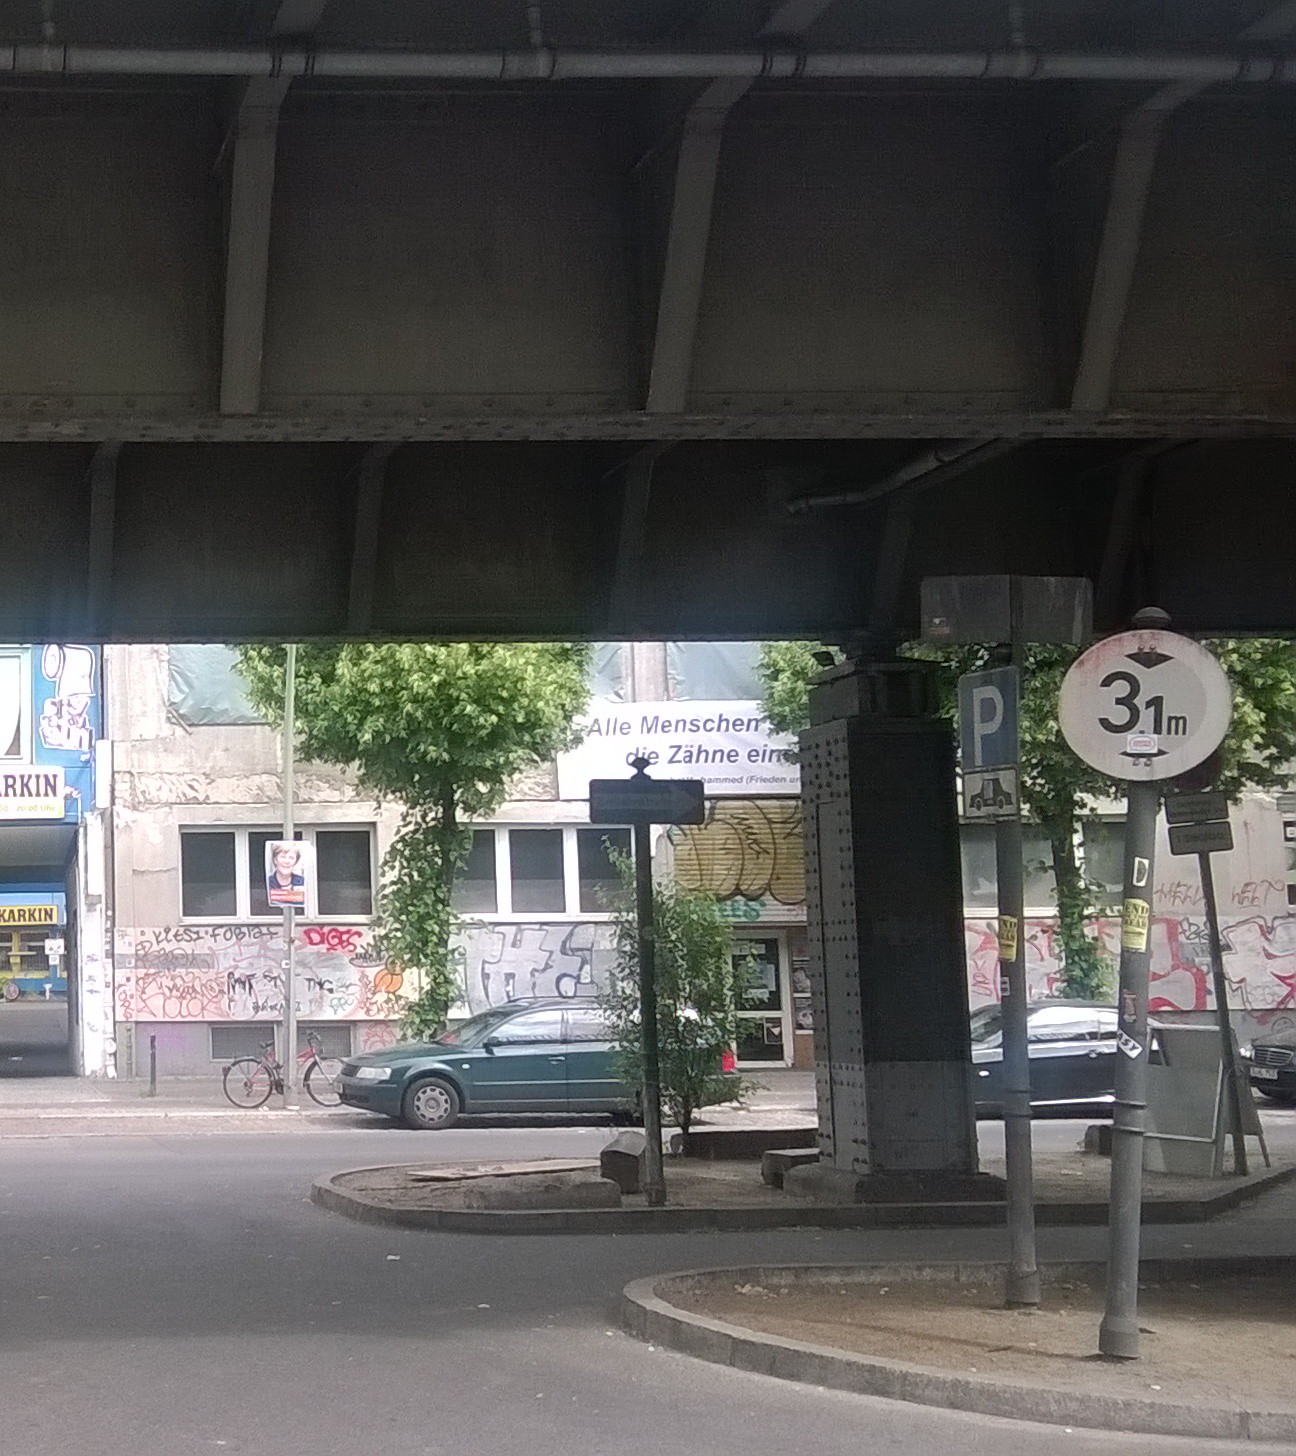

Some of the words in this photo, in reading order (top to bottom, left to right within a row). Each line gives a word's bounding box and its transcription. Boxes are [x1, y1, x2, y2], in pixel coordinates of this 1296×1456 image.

[587, 716, 632, 737] Alle
[640, 713, 760, 735] Menschen
[667, 743, 740, 765] Zähne
